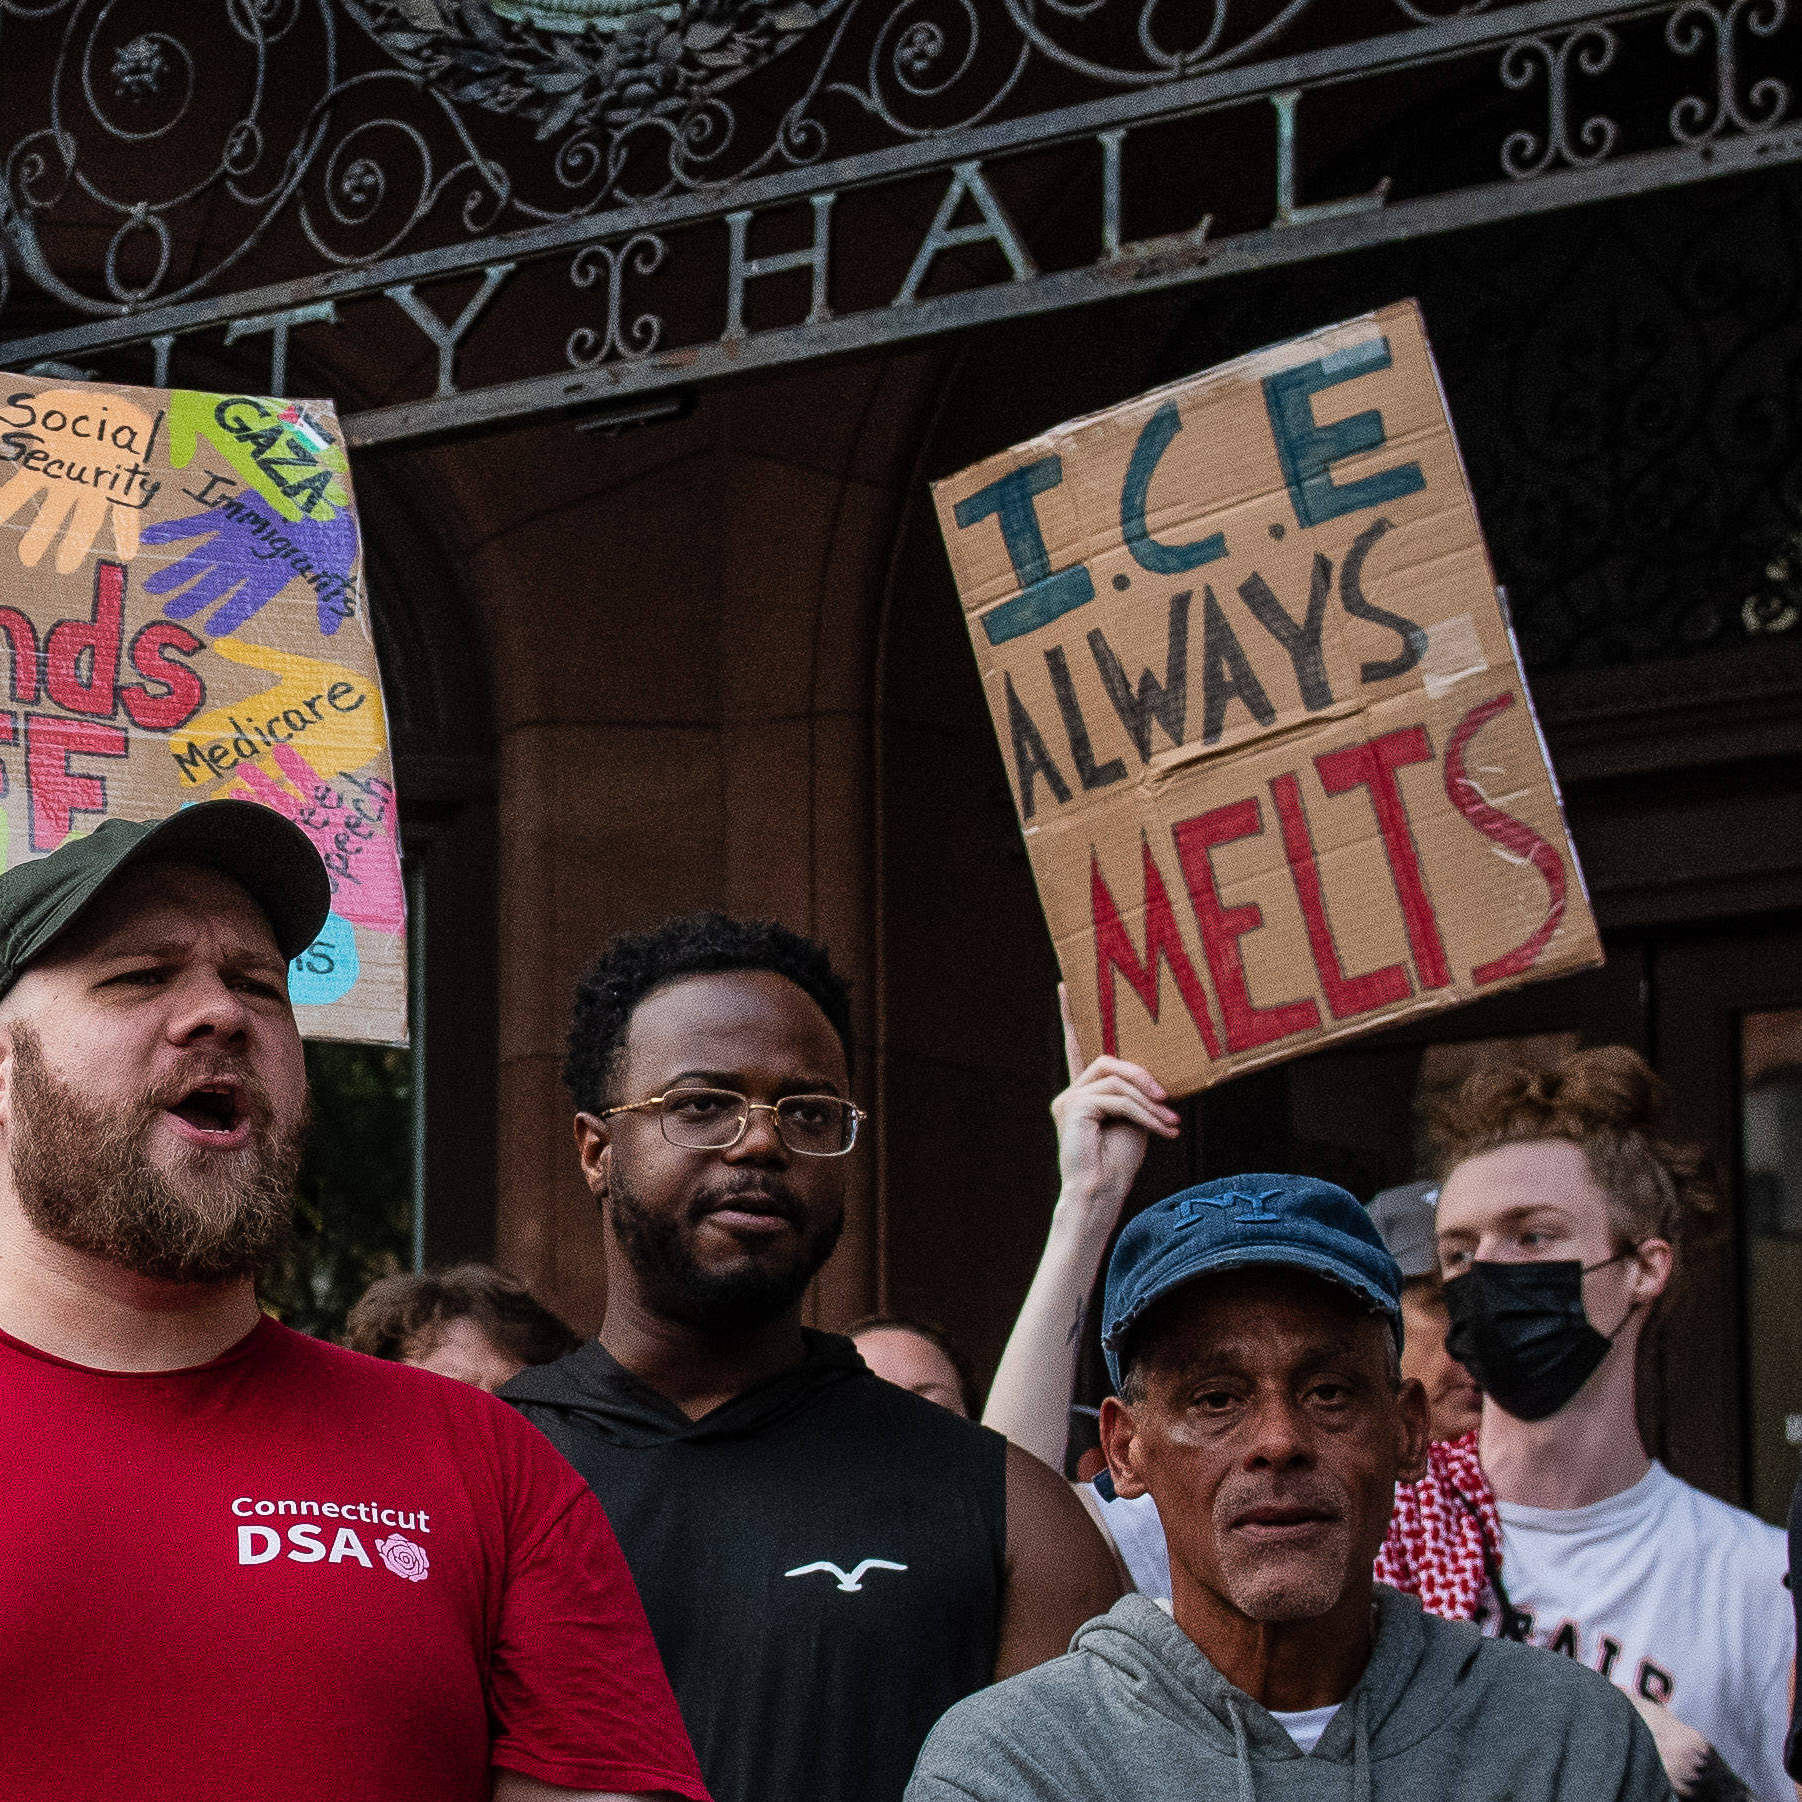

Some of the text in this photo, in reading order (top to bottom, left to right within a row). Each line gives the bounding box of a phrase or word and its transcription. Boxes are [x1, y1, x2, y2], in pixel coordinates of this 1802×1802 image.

[27, 88, 1391, 397] TY HALL
[214, 397, 335, 516] GAZA
[182, 468, 362, 618] Immigrants
[1002, 517, 1430, 820] ALWAYS
[172, 680, 366, 783] Medicare
[291, 784, 345, 831] ee
[1088, 691, 1566, 1062] MELTS
[231, 1497, 431, 1534] Connecticut
[236, 1523, 374, 1569] DSA
